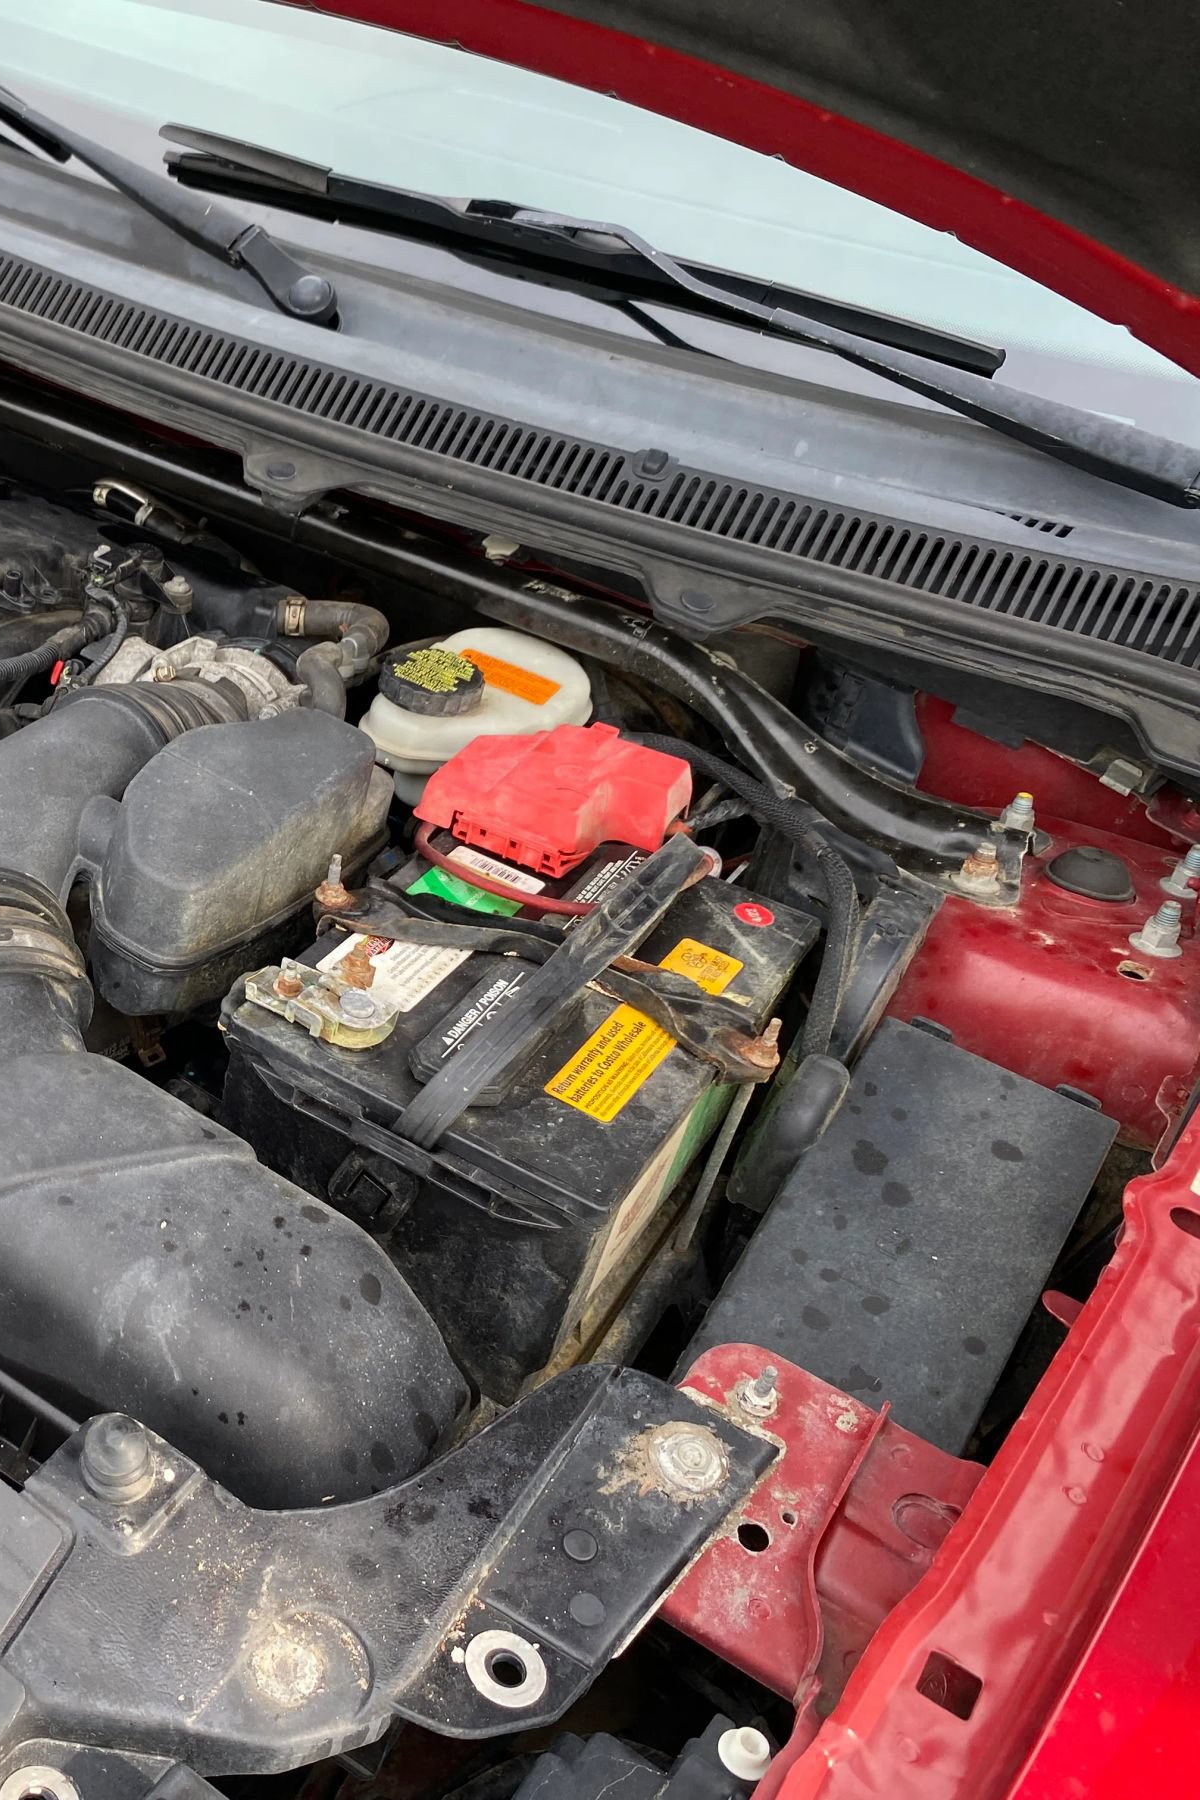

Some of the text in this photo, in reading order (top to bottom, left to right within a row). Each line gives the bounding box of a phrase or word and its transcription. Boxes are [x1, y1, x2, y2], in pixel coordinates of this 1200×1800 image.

[447, 1008, 482, 1038] DANGER
[479, 979, 509, 1006] POISON
[552, 1021, 624, 1094] Return warranty and used
[567, 1021, 647, 1103] batteries to Costco Wholesale
